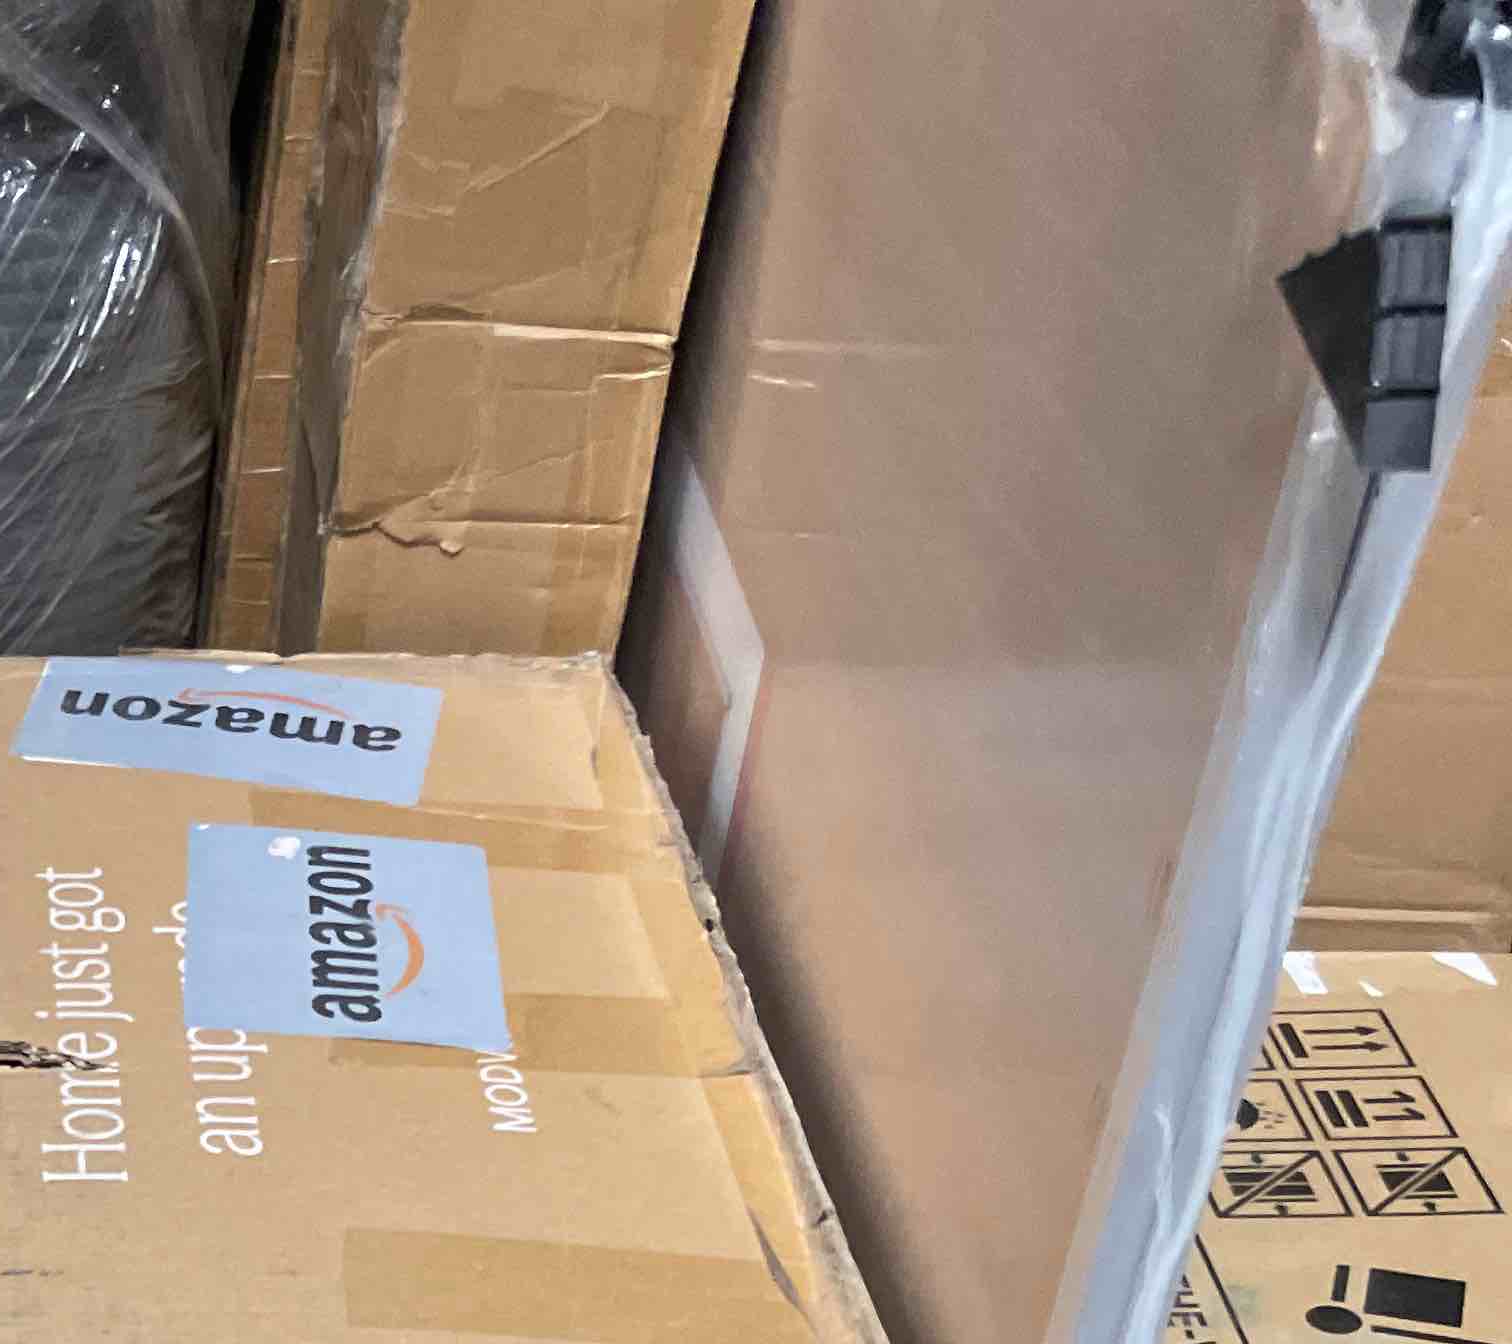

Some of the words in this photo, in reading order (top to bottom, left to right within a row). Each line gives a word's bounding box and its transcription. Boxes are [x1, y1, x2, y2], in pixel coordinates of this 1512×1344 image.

[60, 688, 403, 752] amazon
[35, 867, 127, 934] got
[306, 845, 384, 1024] amazon
[35, 942, 134, 1022] just
[42, 1030, 128, 1182] Home
[195, 1096, 263, 1157] an
